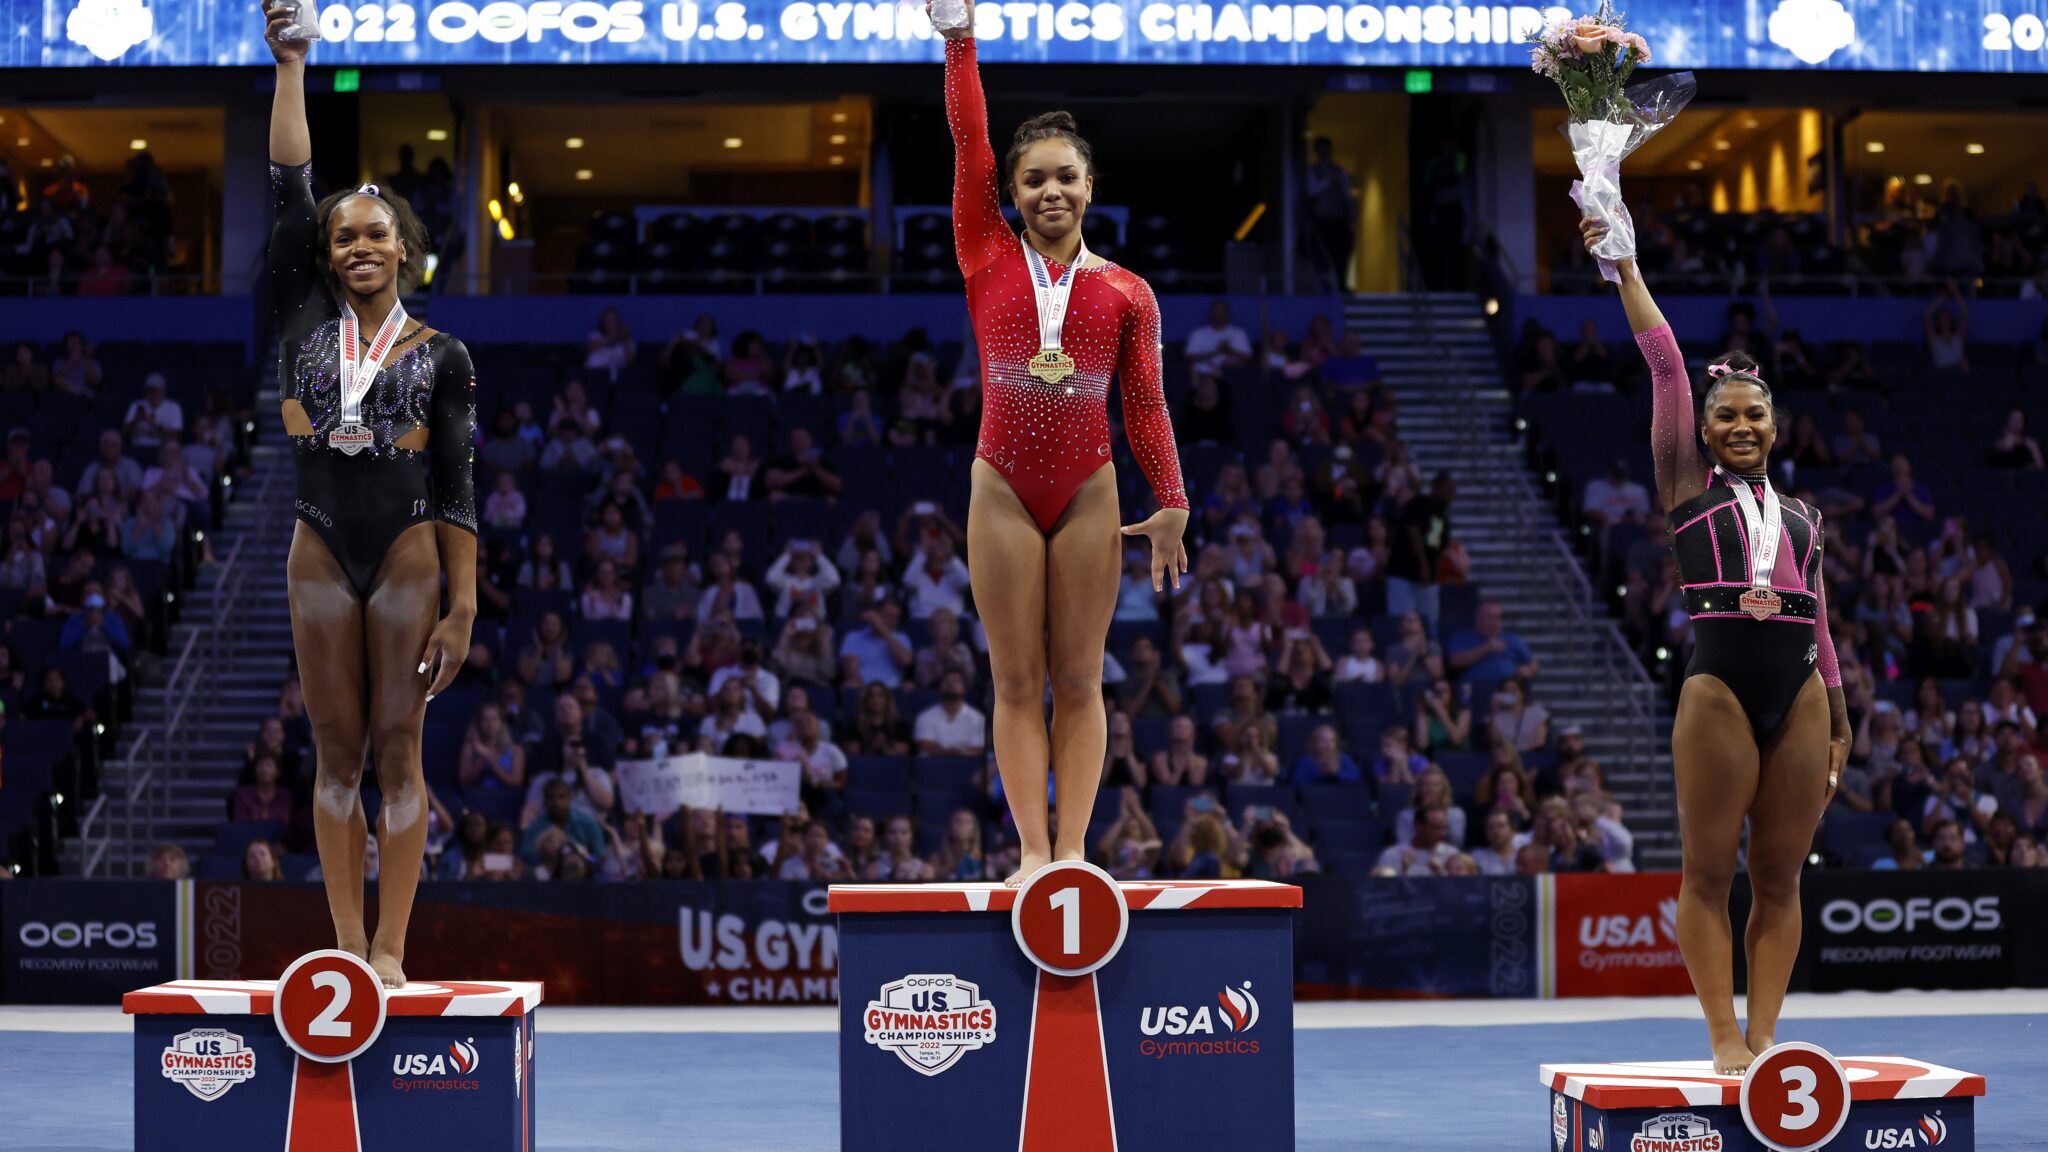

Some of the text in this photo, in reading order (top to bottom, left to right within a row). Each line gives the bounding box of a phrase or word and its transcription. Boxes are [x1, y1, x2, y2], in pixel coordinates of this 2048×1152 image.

[319, 3, 416, 42] 022
[428, 1, 645, 43] OOFOS
[662, 2, 764, 41] U.S.
[780, 2, 1125, 41] GYMNSTICS
[1982, 13, 2048, 51] 20
[1031, 361, 1072, 369] GYMNASTICS
[1044, 353, 1058, 362] US
[331, 433, 372, 441] GYMNASTICS
[344, 425, 357, 434] US
[1742, 597, 1780, 607] GYMNASTICS
[1755, 590, 1768, 599] US
[1049, 887, 1080, 954] 1
[1820, 897, 2001, 934] OOFOS
[19, 922, 157, 948] OOFOS
[205, 885, 242, 979] 022
[679, 906, 752, 970] U.S.
[1579, 915, 1656, 947] USA
[20, 957, 159, 970] RECOVERY FOOTWEAR
[1821, 944, 2001, 964] RECOVERY FOOTWEAR
[907, 978, 953, 987] OOFOS
[308, 970, 352, 1037] 2
[911, 990, 949, 1012] U.S.
[868, 1008, 992, 1030] GYMNASTICS
[1140, 1006, 1214, 1036] USA
[879, 1031, 981, 1040] CHAMPIONSHIPS
[1140, 1037, 1260, 1060] Gymnastics
[165, 1052, 252, 1069] GYMNASTICS
[393, 1054, 446, 1075] USA
[393, 1077, 480, 1092] Gymnastics
[1779, 1065, 1820, 1130] 3
[1634, 1135, 1720, 1152] GYMNASTICS
[1865, 1127, 1916, 1149] USA
